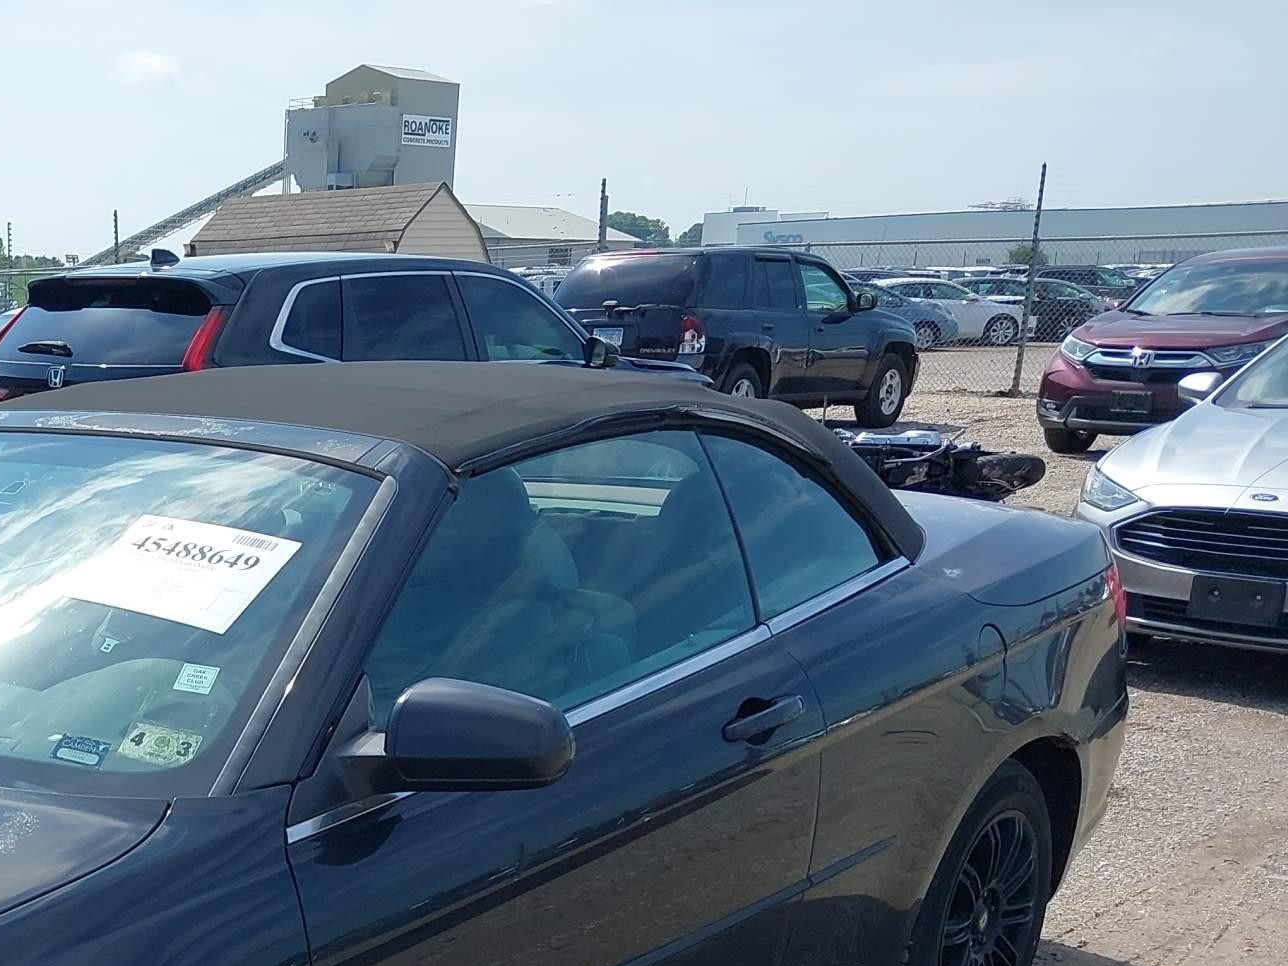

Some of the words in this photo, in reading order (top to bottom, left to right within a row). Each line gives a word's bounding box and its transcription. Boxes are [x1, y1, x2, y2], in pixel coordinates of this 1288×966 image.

[403, 119, 450, 136] ROANOKE
[132, 536, 260, 570] 45488649
[130, 732, 146, 746] 4
[176, 742, 192, 757] 3
